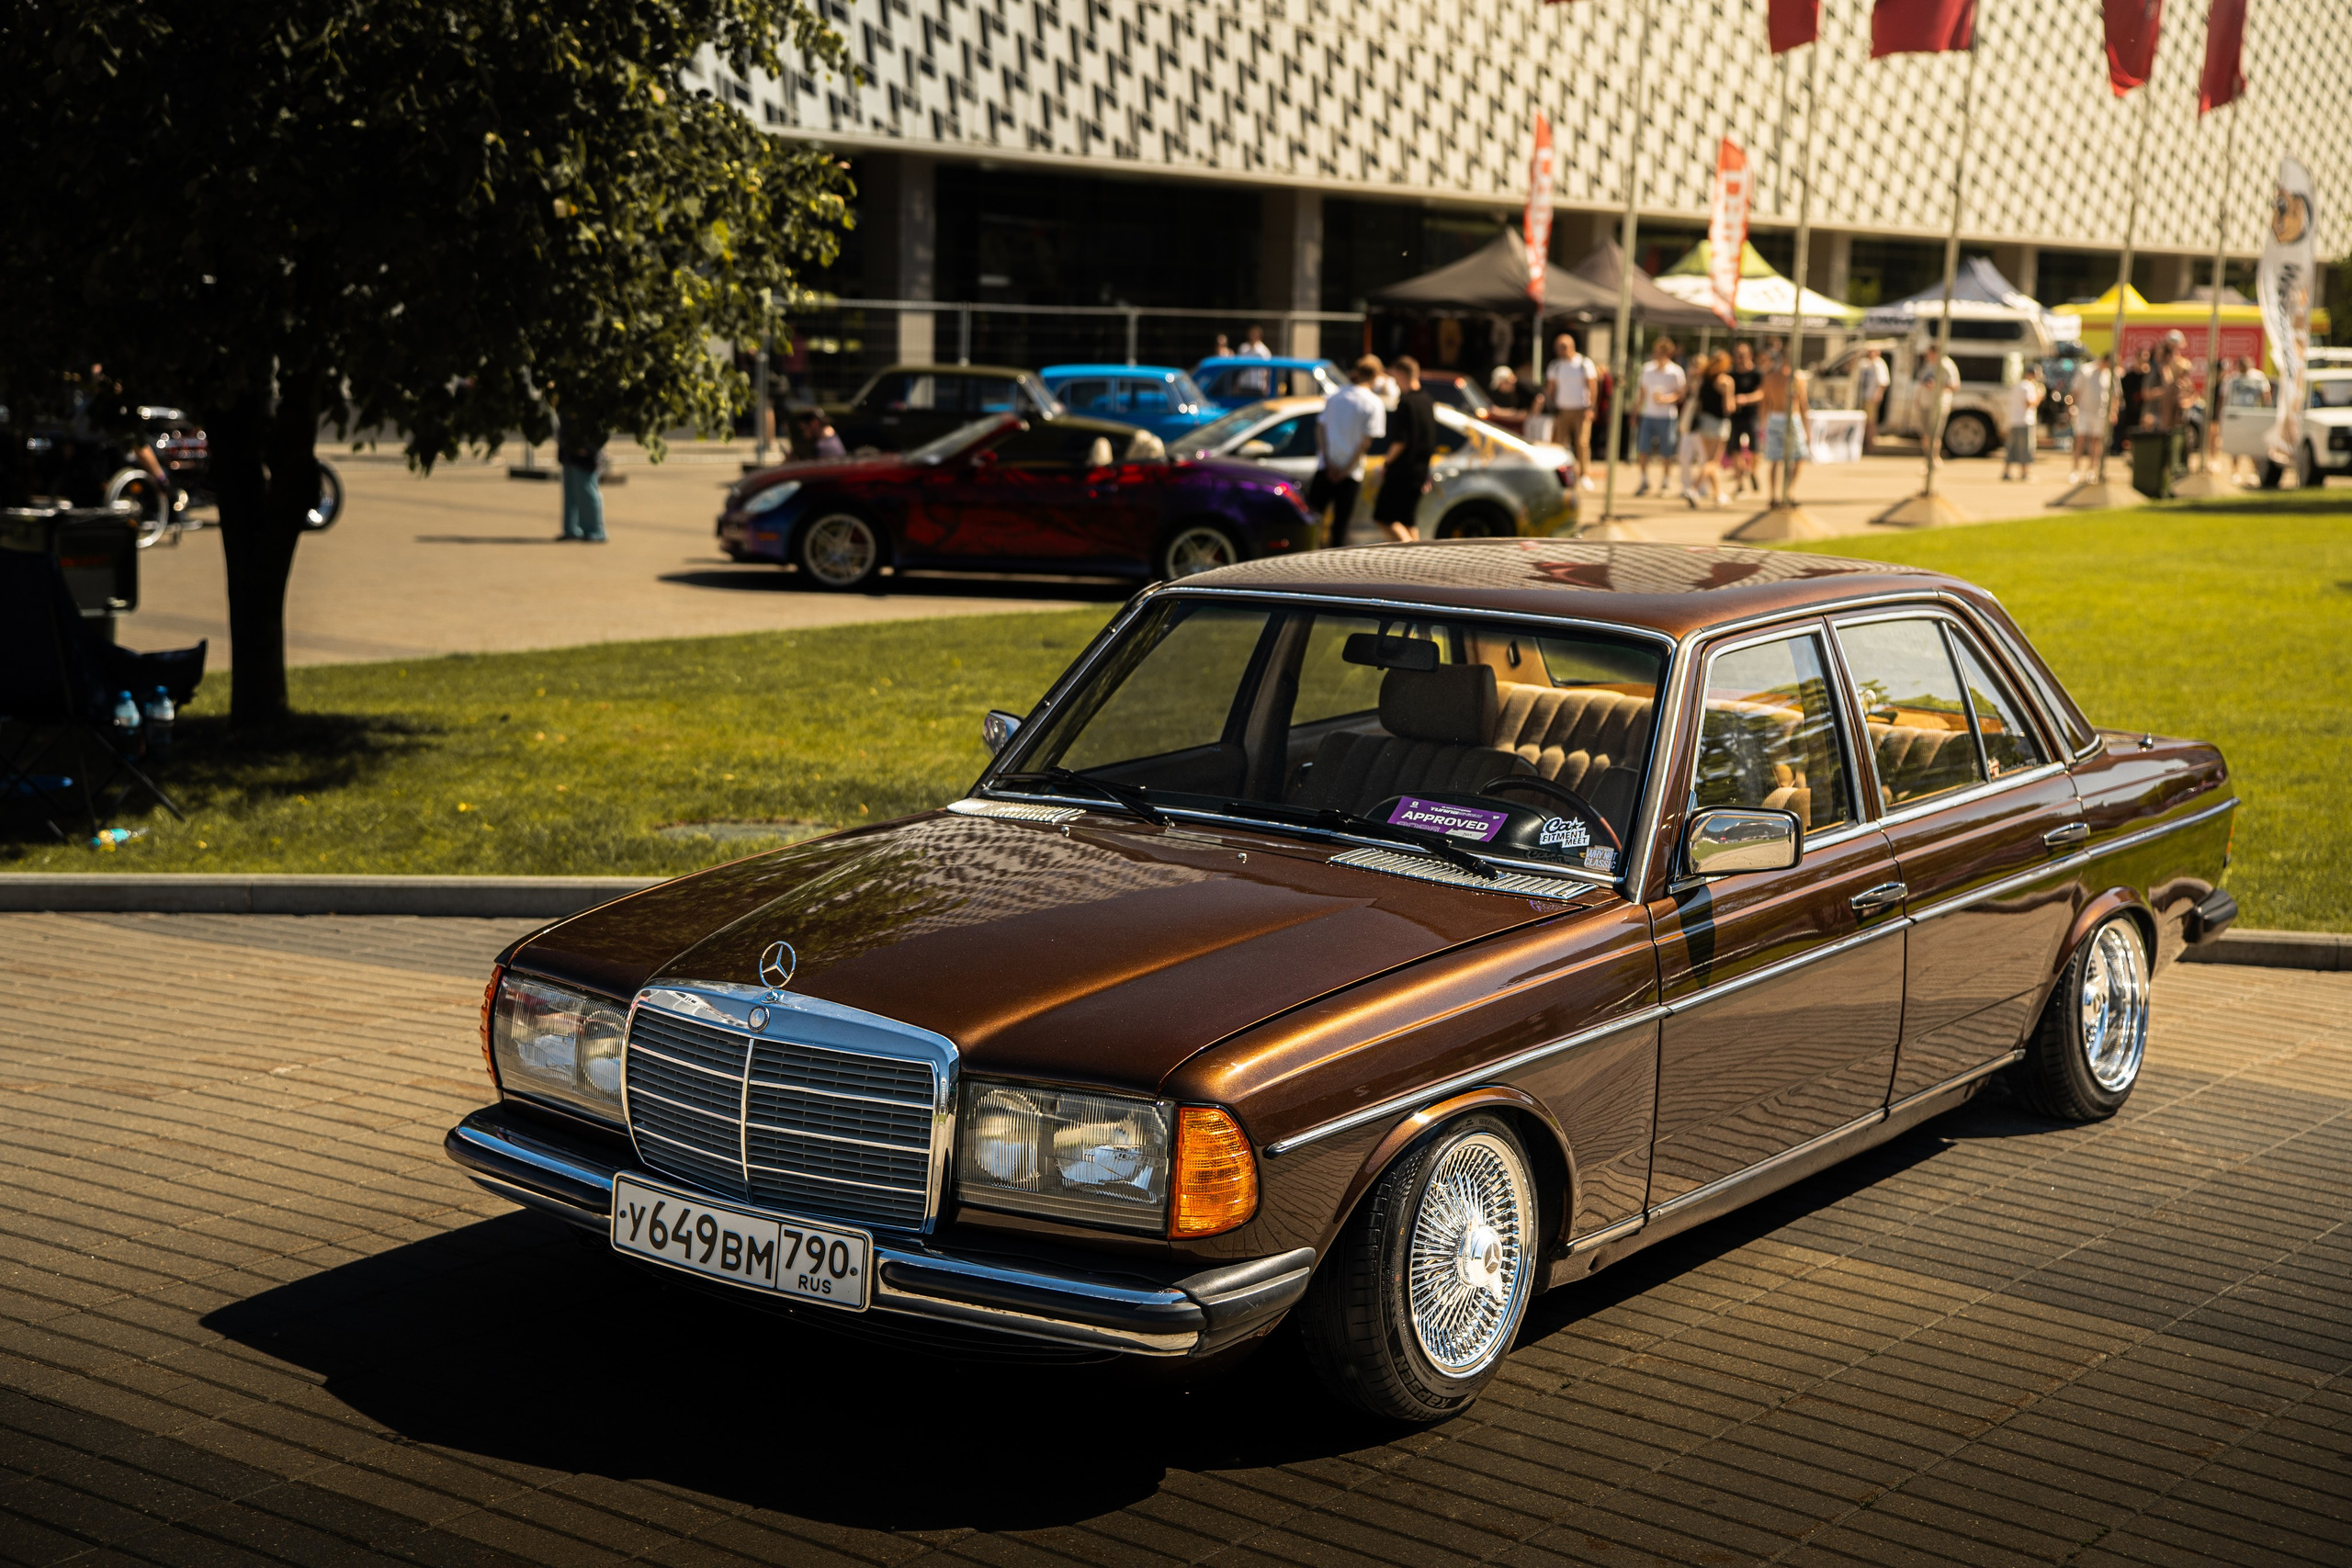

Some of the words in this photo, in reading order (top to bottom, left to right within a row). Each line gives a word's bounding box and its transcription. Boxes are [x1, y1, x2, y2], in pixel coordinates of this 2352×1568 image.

[1401, 810, 1489, 831] APPROVED
[1543, 830, 1583, 842] FITMENT
[1565, 837, 1587, 846] MEET
[1586, 848, 1603, 860] WHY
[1603, 850, 1618, 862] NOT
[1584, 857, 1616, 869] CLASSIC
[784, 1229, 849, 1280] 790
[798, 1274, 831, 1294] RUS
